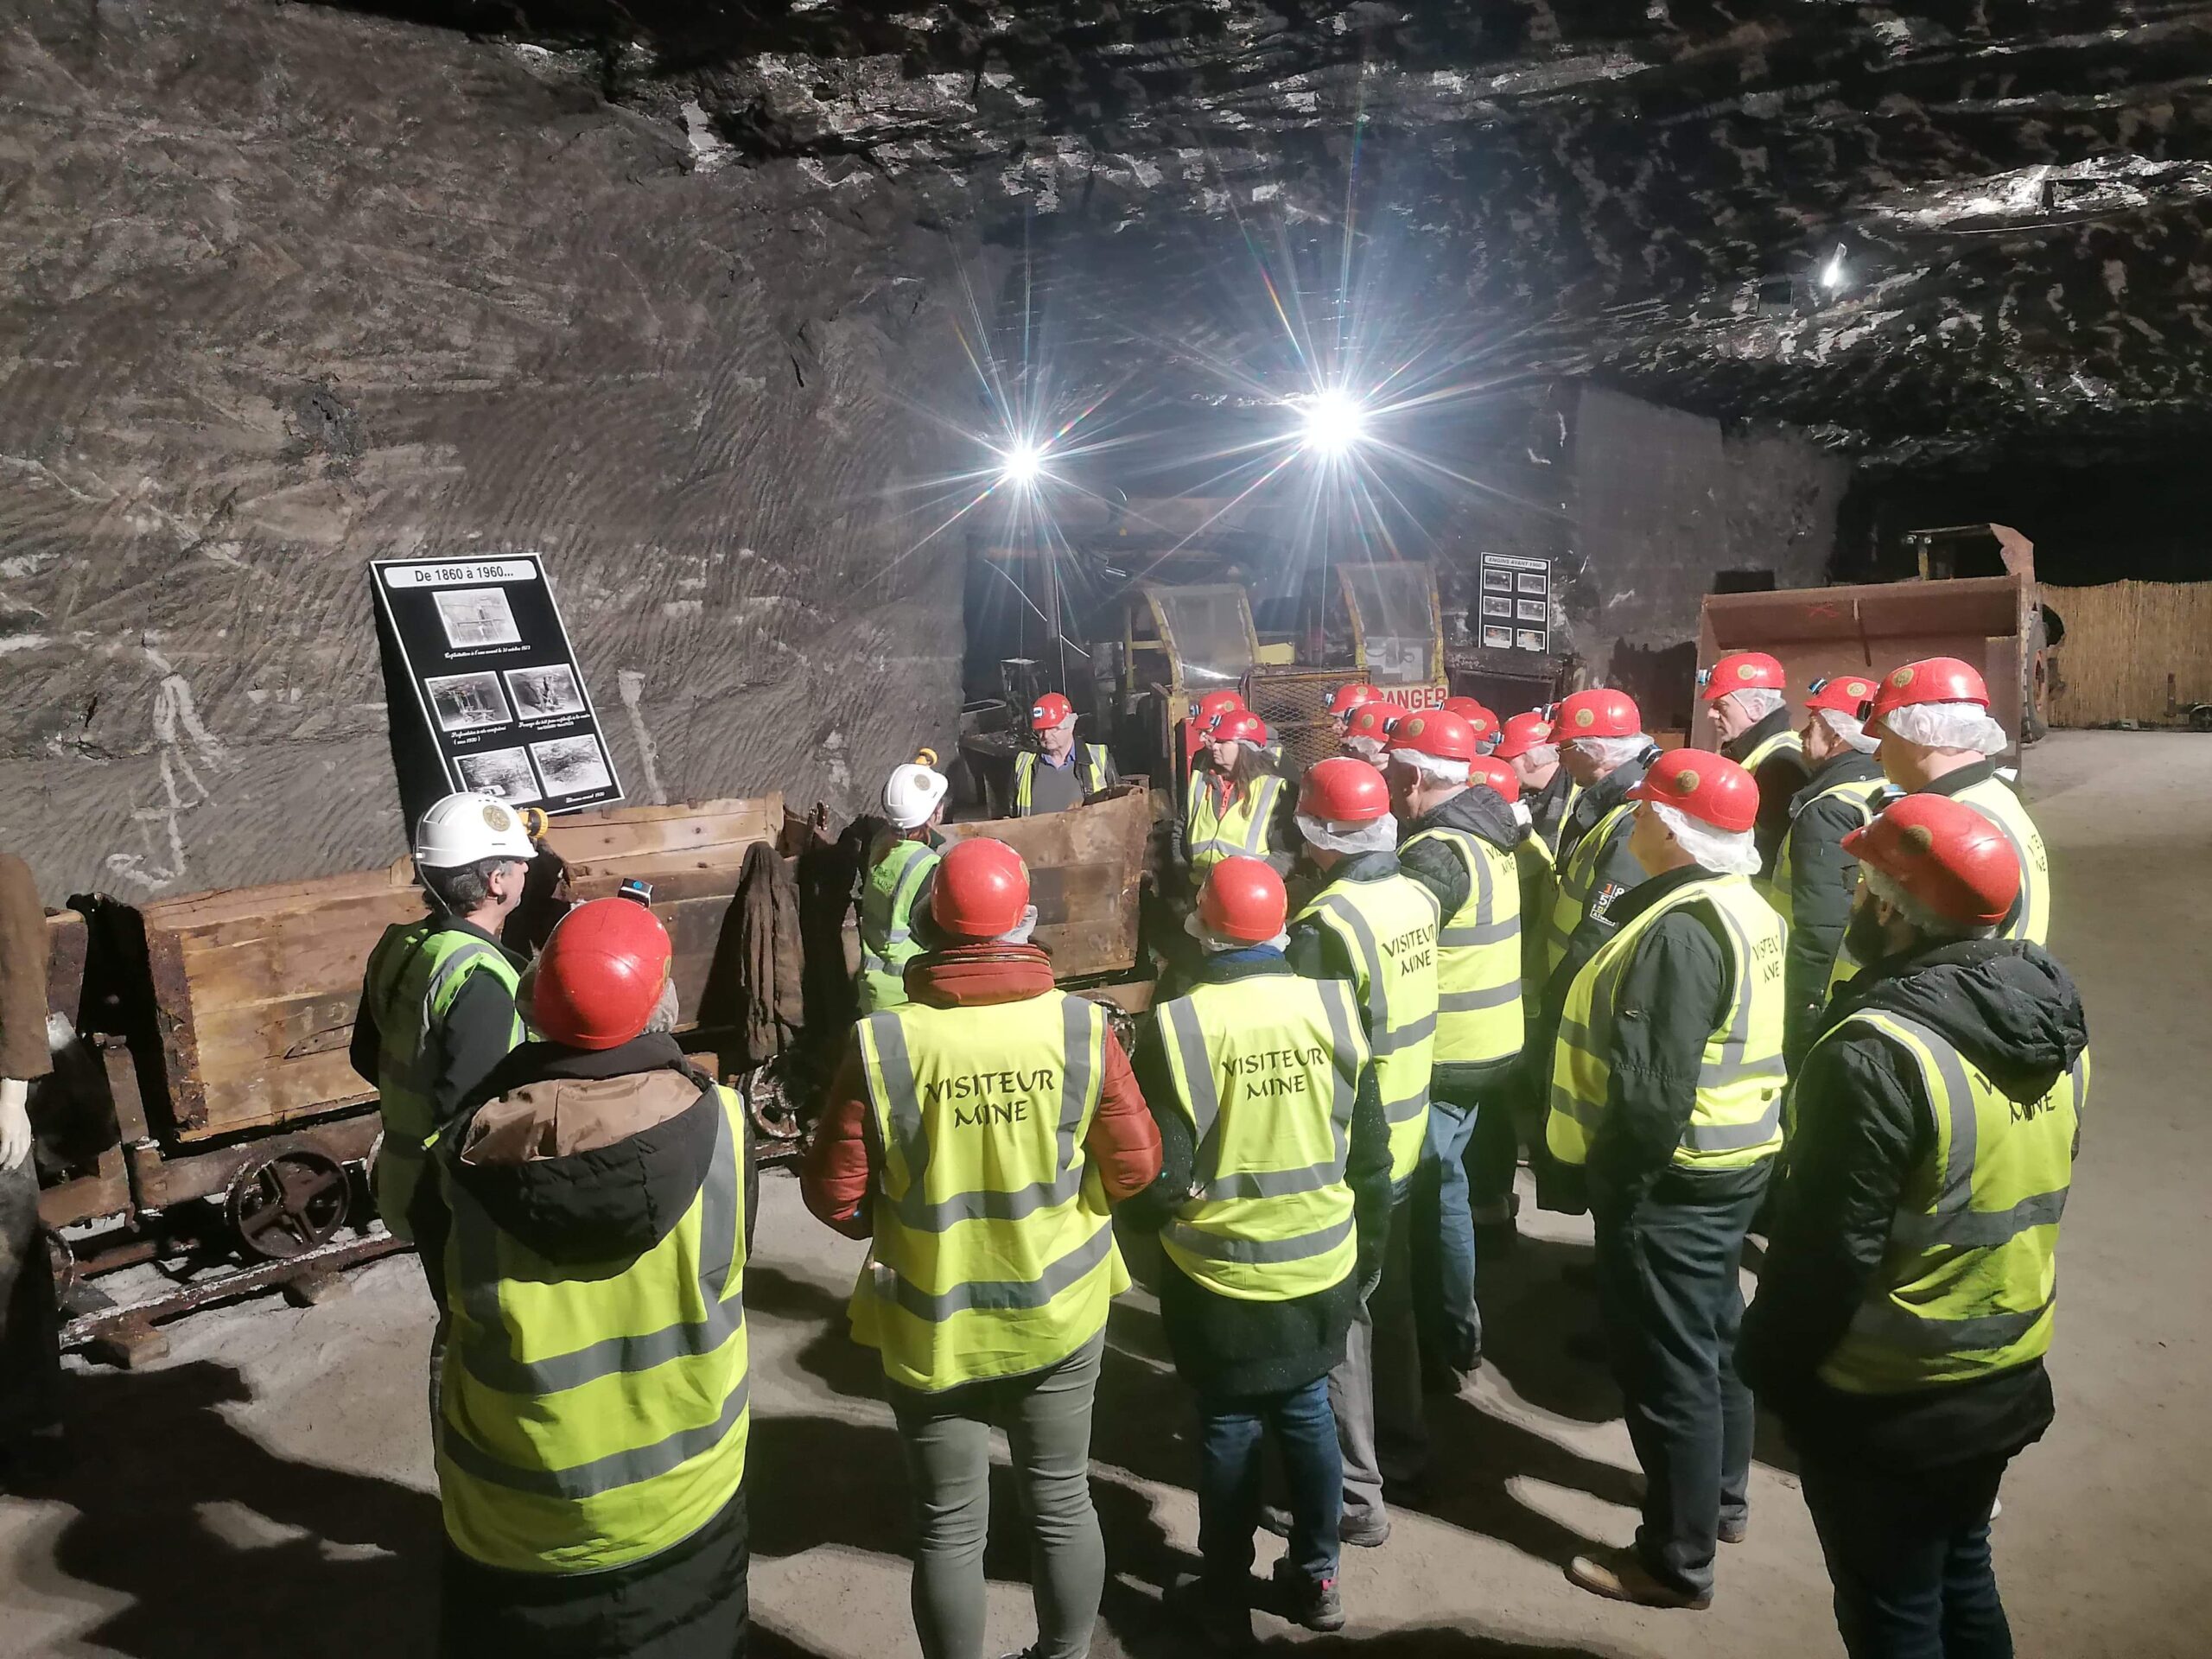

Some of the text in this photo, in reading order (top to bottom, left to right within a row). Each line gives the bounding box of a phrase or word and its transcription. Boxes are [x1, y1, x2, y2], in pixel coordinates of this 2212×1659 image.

[415, 566, 513, 582] De 1860 à 1960...
[1382, 688, 1446, 709] ANGER
[1221, 1047, 1325, 1077] VISITEUR
[925, 1069, 1055, 1103] VISITEUR
[1246, 1074, 1306, 1101] MINE
[954, 1100, 1028, 1128] MINE
